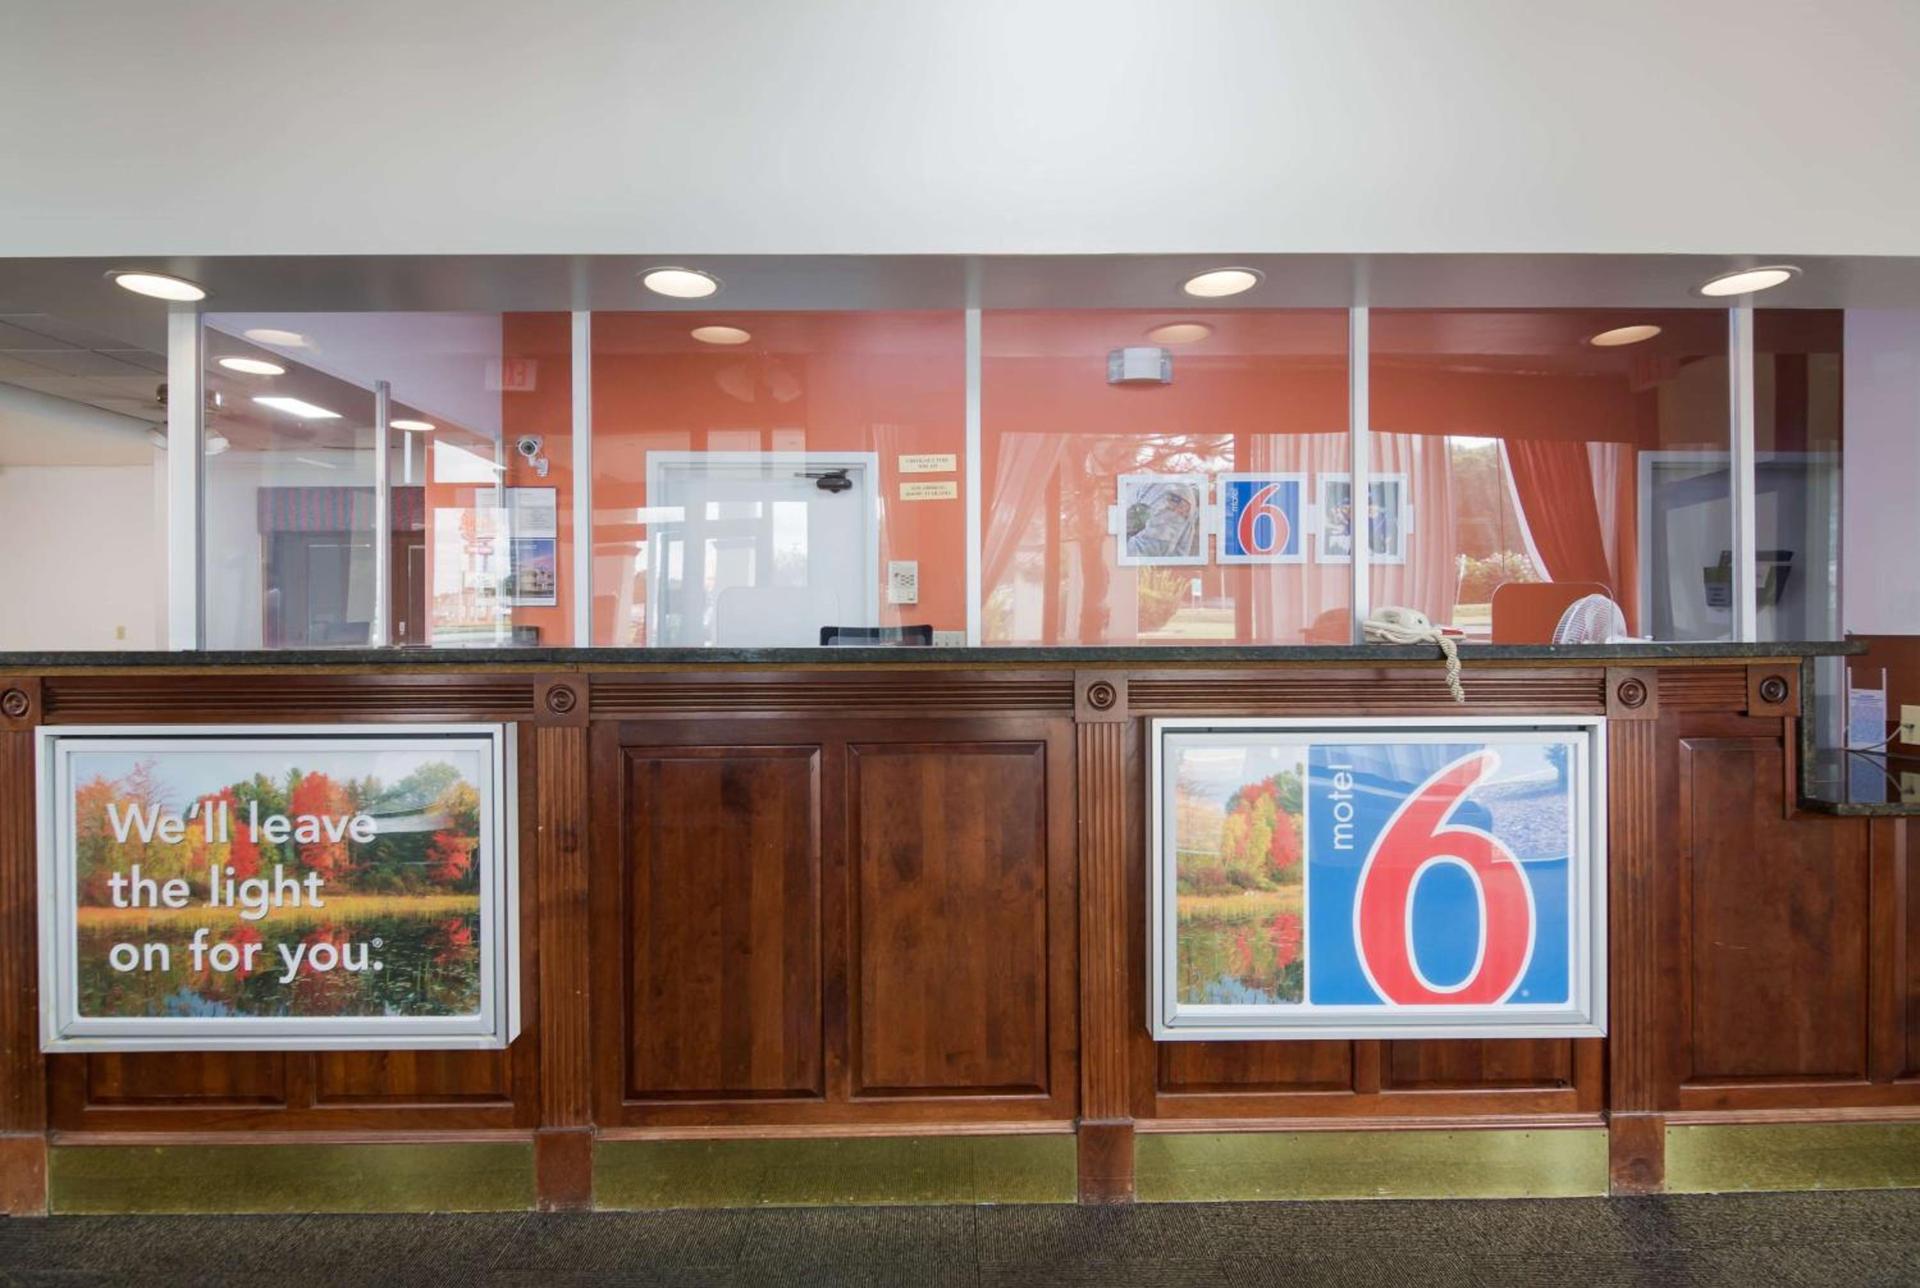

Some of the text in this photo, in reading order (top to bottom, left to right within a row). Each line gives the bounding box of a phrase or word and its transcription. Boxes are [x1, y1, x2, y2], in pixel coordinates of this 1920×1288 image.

[1237, 482, 1290, 556] 6
[107, 800, 379, 844] We'll leave
[107, 863, 325, 920] the light
[1328, 749, 1537, 1006] motel 6
[108, 942, 171, 972] on
[188, 927, 263, 972] for
